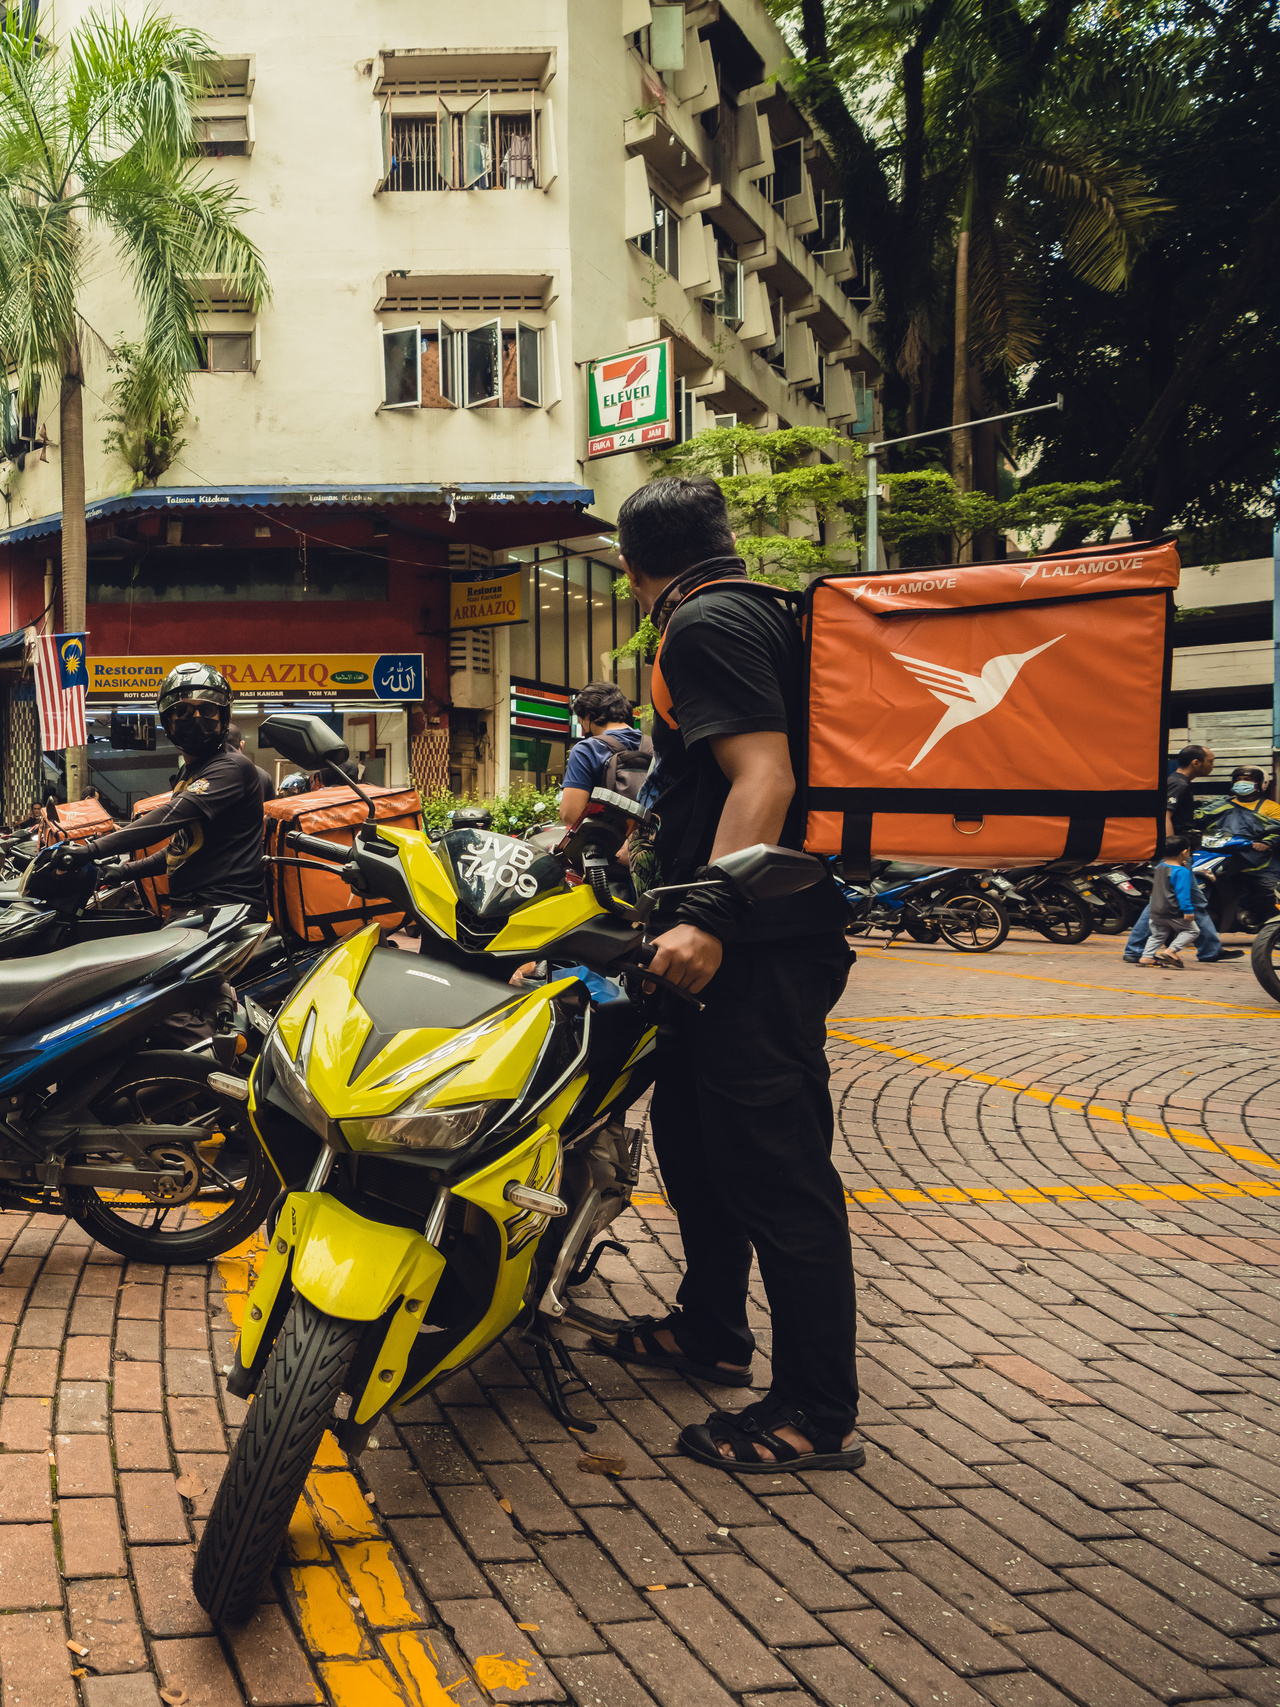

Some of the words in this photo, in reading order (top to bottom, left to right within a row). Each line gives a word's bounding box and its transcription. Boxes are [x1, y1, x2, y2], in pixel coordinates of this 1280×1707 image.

[602, 354, 648, 421] 7
[592, 440, 611, 451] BUKA
[619, 432, 636, 447] 24
[647, 427, 662, 439] JAM
[166, 496, 196, 504] Taiwan
[199, 494, 230, 503] Kitchen
[309, 494, 339, 502] Taiwan
[485, 492, 516, 501] itchen
[1040, 557, 1144, 579] LALAMOVE
[467, 585, 503, 597] Restoran
[867, 578, 957, 598] LALAMOVE
[453, 599, 516, 621] ARRAAZIQ
[94, 664, 164, 676] Restoran
[94, 678, 164, 688] NASIKANDA
[467, 836, 534, 870] JVB
[460, 854, 538, 899] 7409
